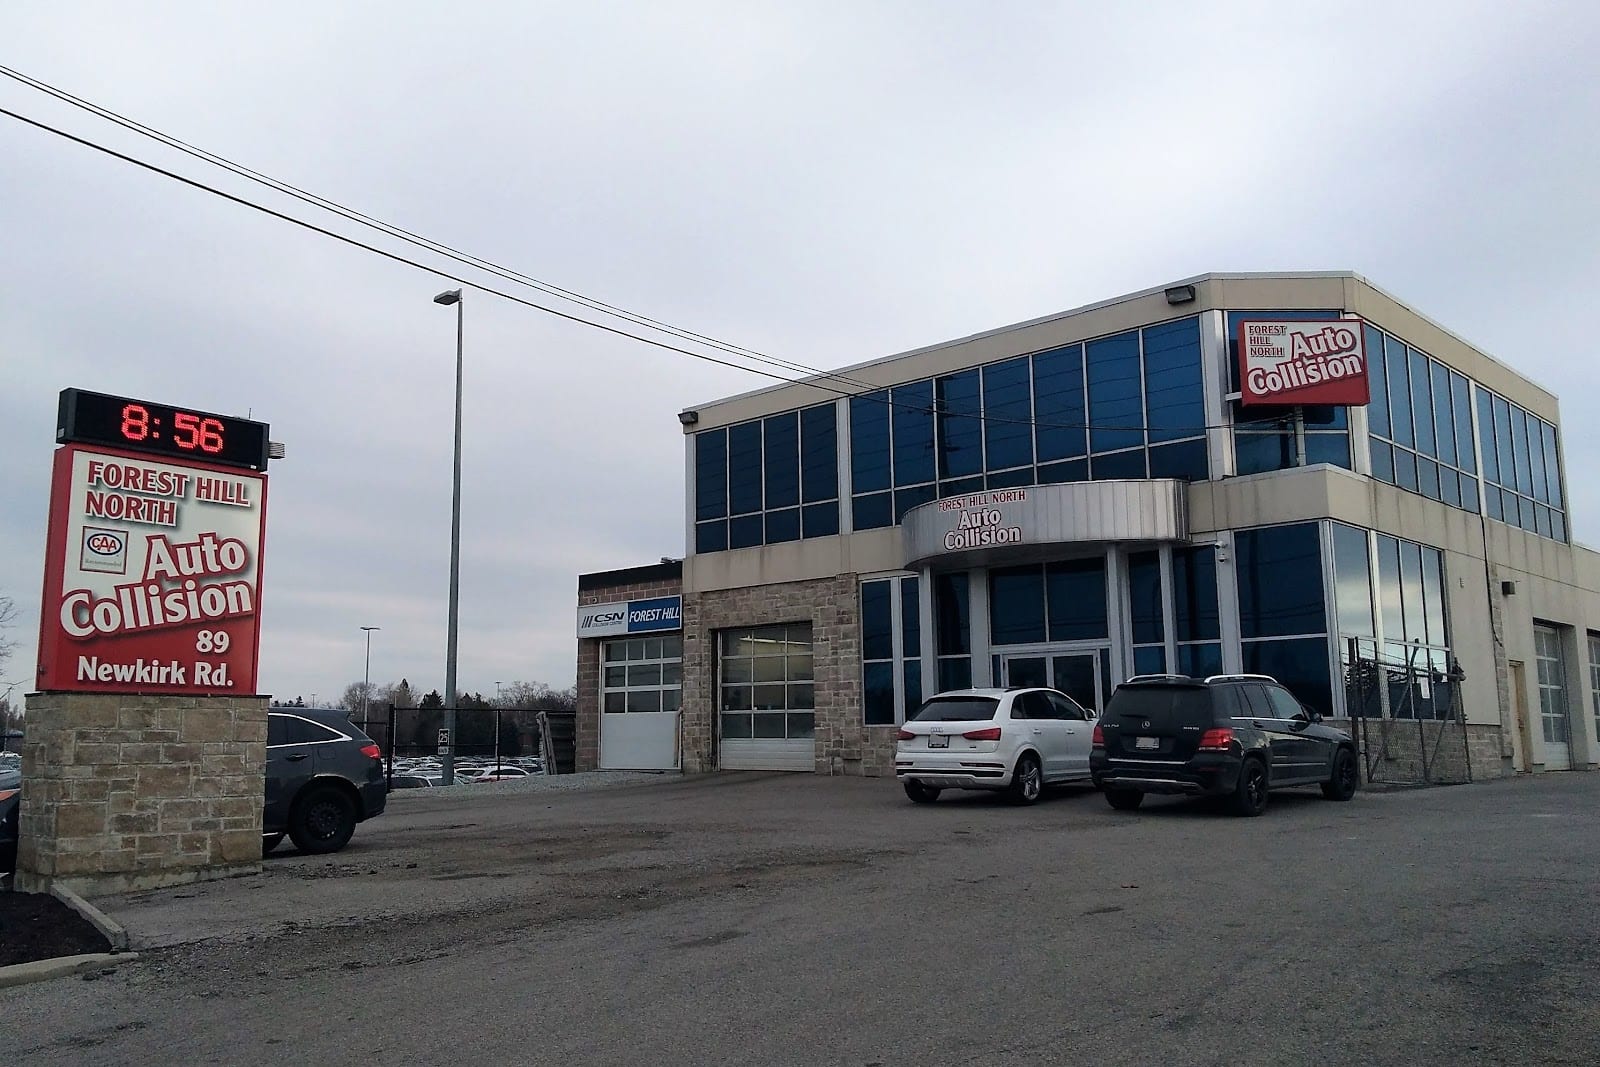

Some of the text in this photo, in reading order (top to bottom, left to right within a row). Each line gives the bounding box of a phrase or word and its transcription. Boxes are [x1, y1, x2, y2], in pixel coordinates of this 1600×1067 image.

[1248, 325, 1286, 335] FOREST
[1249, 336, 1271, 346] HILL
[1250, 347, 1285, 357] NORTH
[1291, 328, 1353, 358] Auto
[1248, 355, 1362, 395] Collision
[87, 461, 250, 506] FOREST HILL
[85, 491, 177, 527] NORTH
[939, 490, 1026, 512] FOREST HILL NORTH
[958, 508, 1001, 530] Auto
[91, 536, 118, 552] CAA
[944, 526, 1021, 550] Collision
[145, 532, 246, 581] Auto
[60, 579, 252, 637] Collision
[594, 612, 625, 623] CSN
[629, 606, 680, 623] FOREST HILL
[195, 630, 230, 654] 89
[77, 655, 233, 687] Newkirk Rd.
